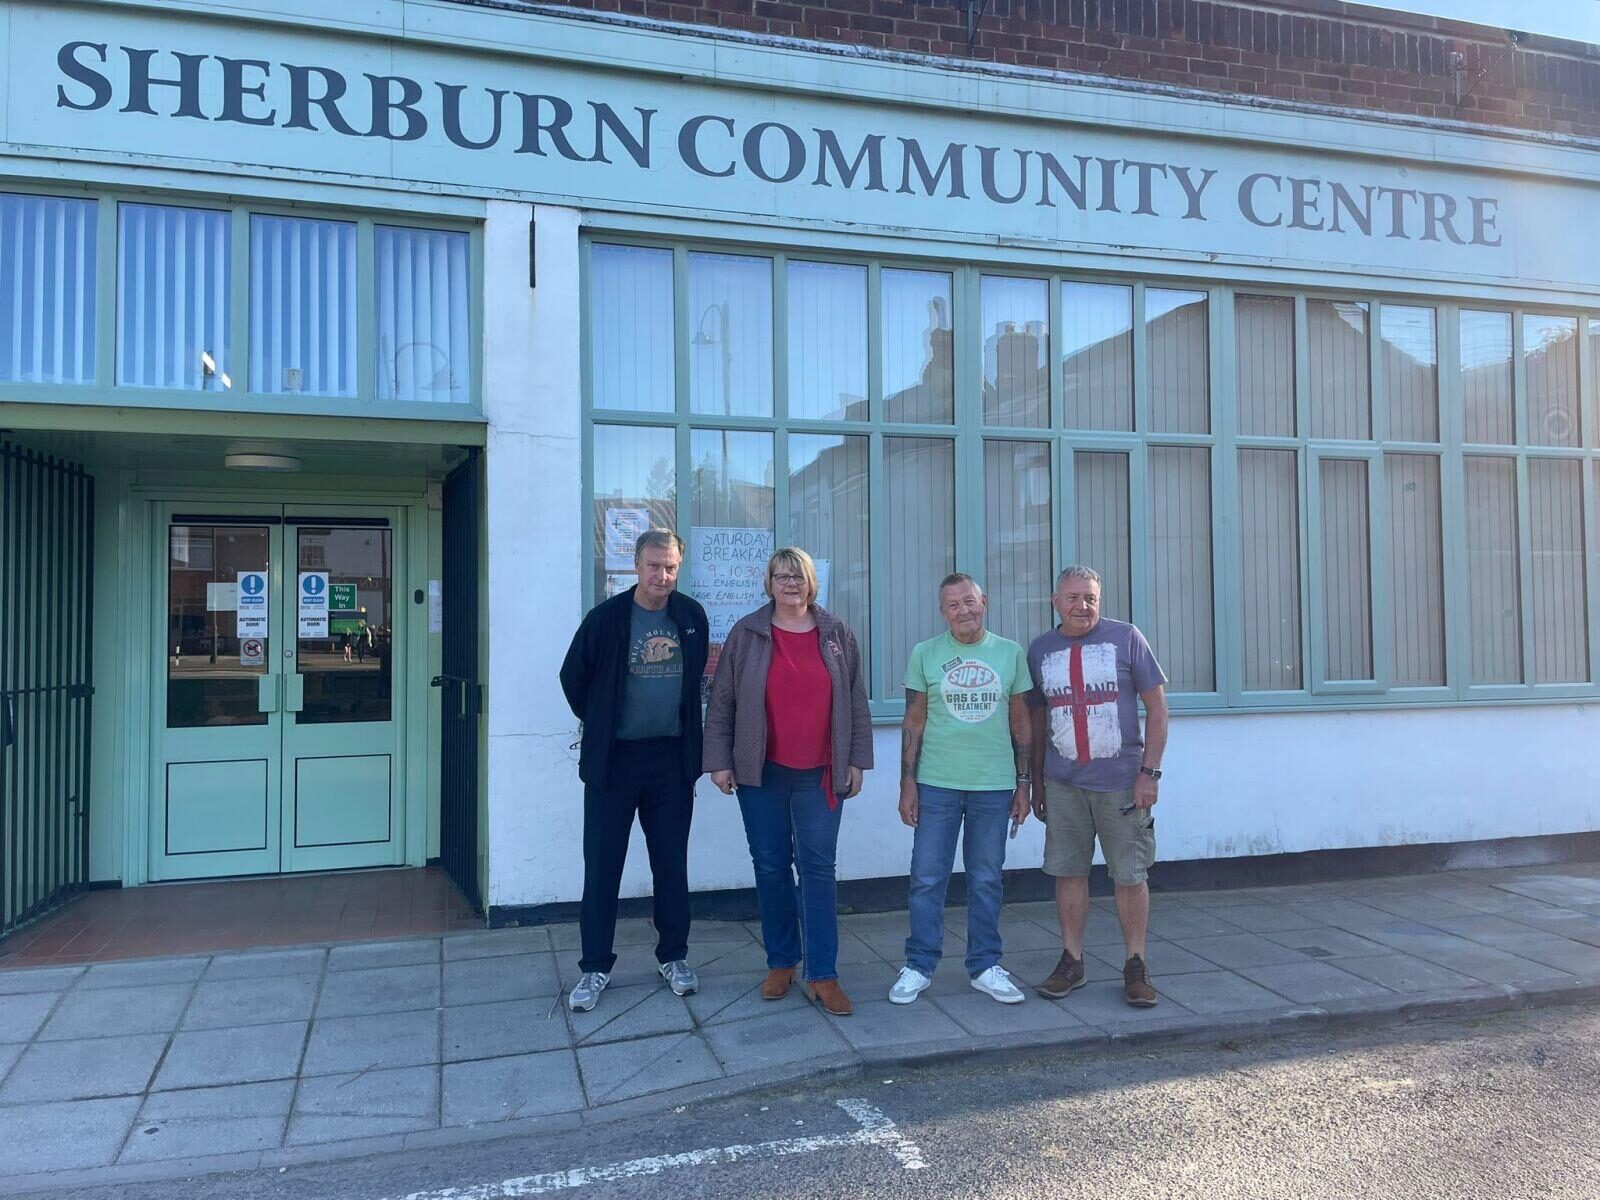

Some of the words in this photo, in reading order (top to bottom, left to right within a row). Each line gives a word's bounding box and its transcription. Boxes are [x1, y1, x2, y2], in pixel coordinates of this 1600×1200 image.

[56, 41, 658, 169] SHERBURN
[677, 114, 1218, 222] COMMUNITY
[1237, 172, 1503, 248] CENTRE
[703, 532, 772, 547] SATURDAY
[703, 546, 773, 562] BREAKFAS
[708, 564, 717, 577] 9
[690, 579, 709, 588] ULL
[713, 578, 758, 588] ENGLISH
[334, 594, 350, 602] Way
[715, 590, 755, 600] ENGLISH
[949, 666, 994, 688] SUPER
[946, 693, 968, 703] GAS
[970, 692, 979, 702] &
[981, 692, 998, 702] OIL
[953, 702, 992, 711] TREATMENT
